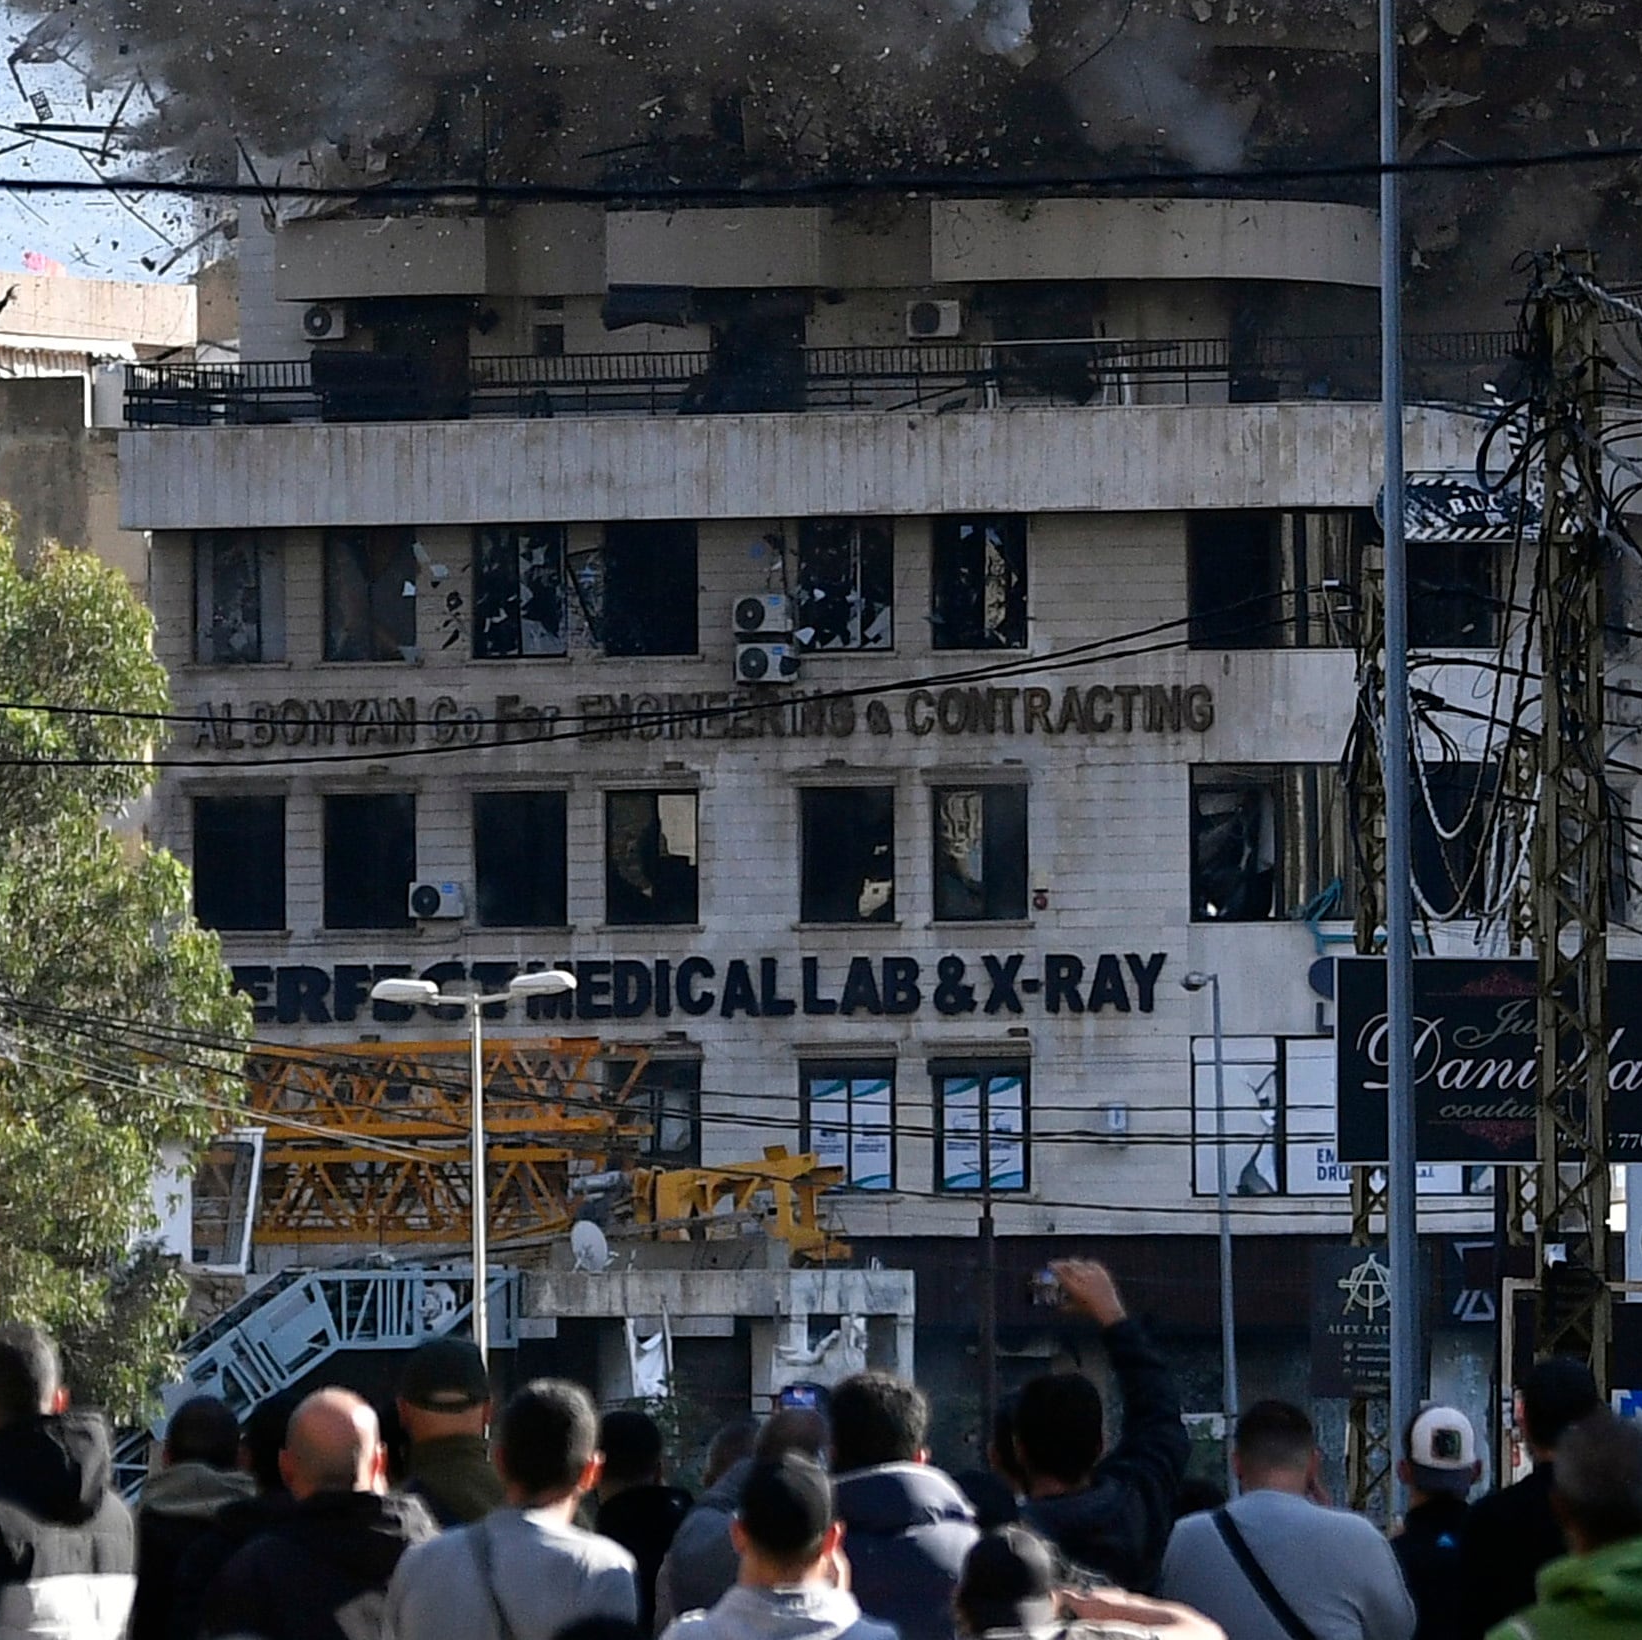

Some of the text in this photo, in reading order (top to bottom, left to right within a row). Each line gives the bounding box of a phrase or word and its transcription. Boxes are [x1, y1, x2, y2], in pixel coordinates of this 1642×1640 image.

[904, 683, 1216, 737] CONTRACTING
[232, 961, 520, 1025] ERFECT
[802, 955, 923, 1018] LAB
[933, 953, 977, 1016] &
[983, 952, 1168, 1016] X-RAY
[1327, 1324, 1361, 1336] ALEX
